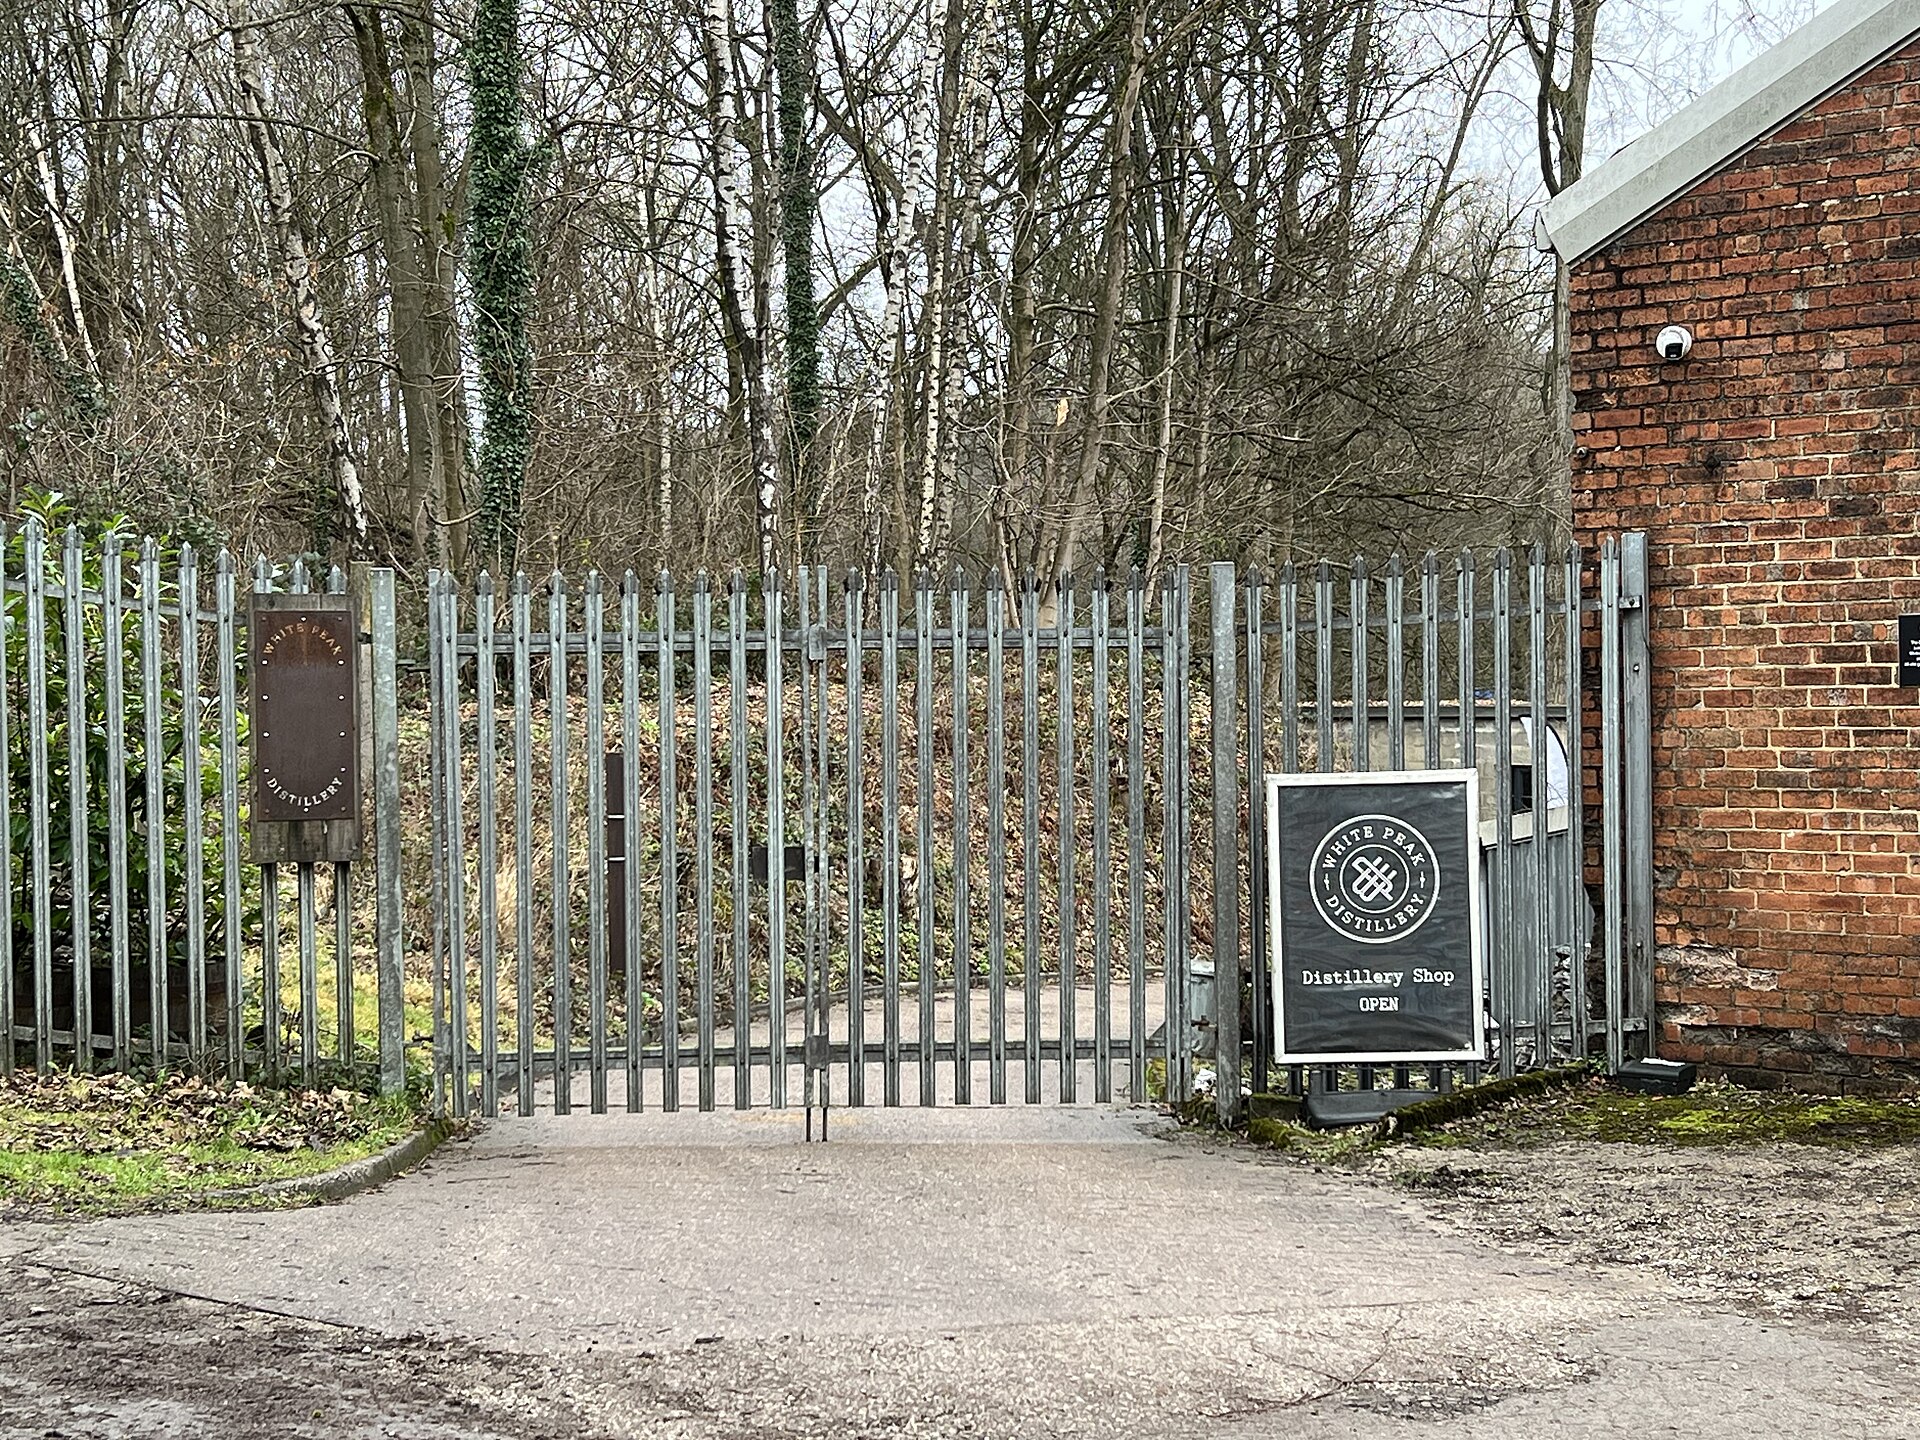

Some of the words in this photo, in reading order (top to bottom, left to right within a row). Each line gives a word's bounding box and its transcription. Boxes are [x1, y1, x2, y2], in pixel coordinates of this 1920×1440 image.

[264, 622, 304, 655] WHITE
[311, 625, 344, 656] PEAK
[266, 776, 344, 807] DISTILLERY
[1322, 825, 1374, 870] WHITE
[1382, 826, 1426, 867] PEAK
[1325, 893, 1425, 933] DISTILLERY
[1302, 969, 1403, 988] Distillery
[1413, 967, 1455, 987] Shop
[1359, 996, 1400, 1012] OPEN
